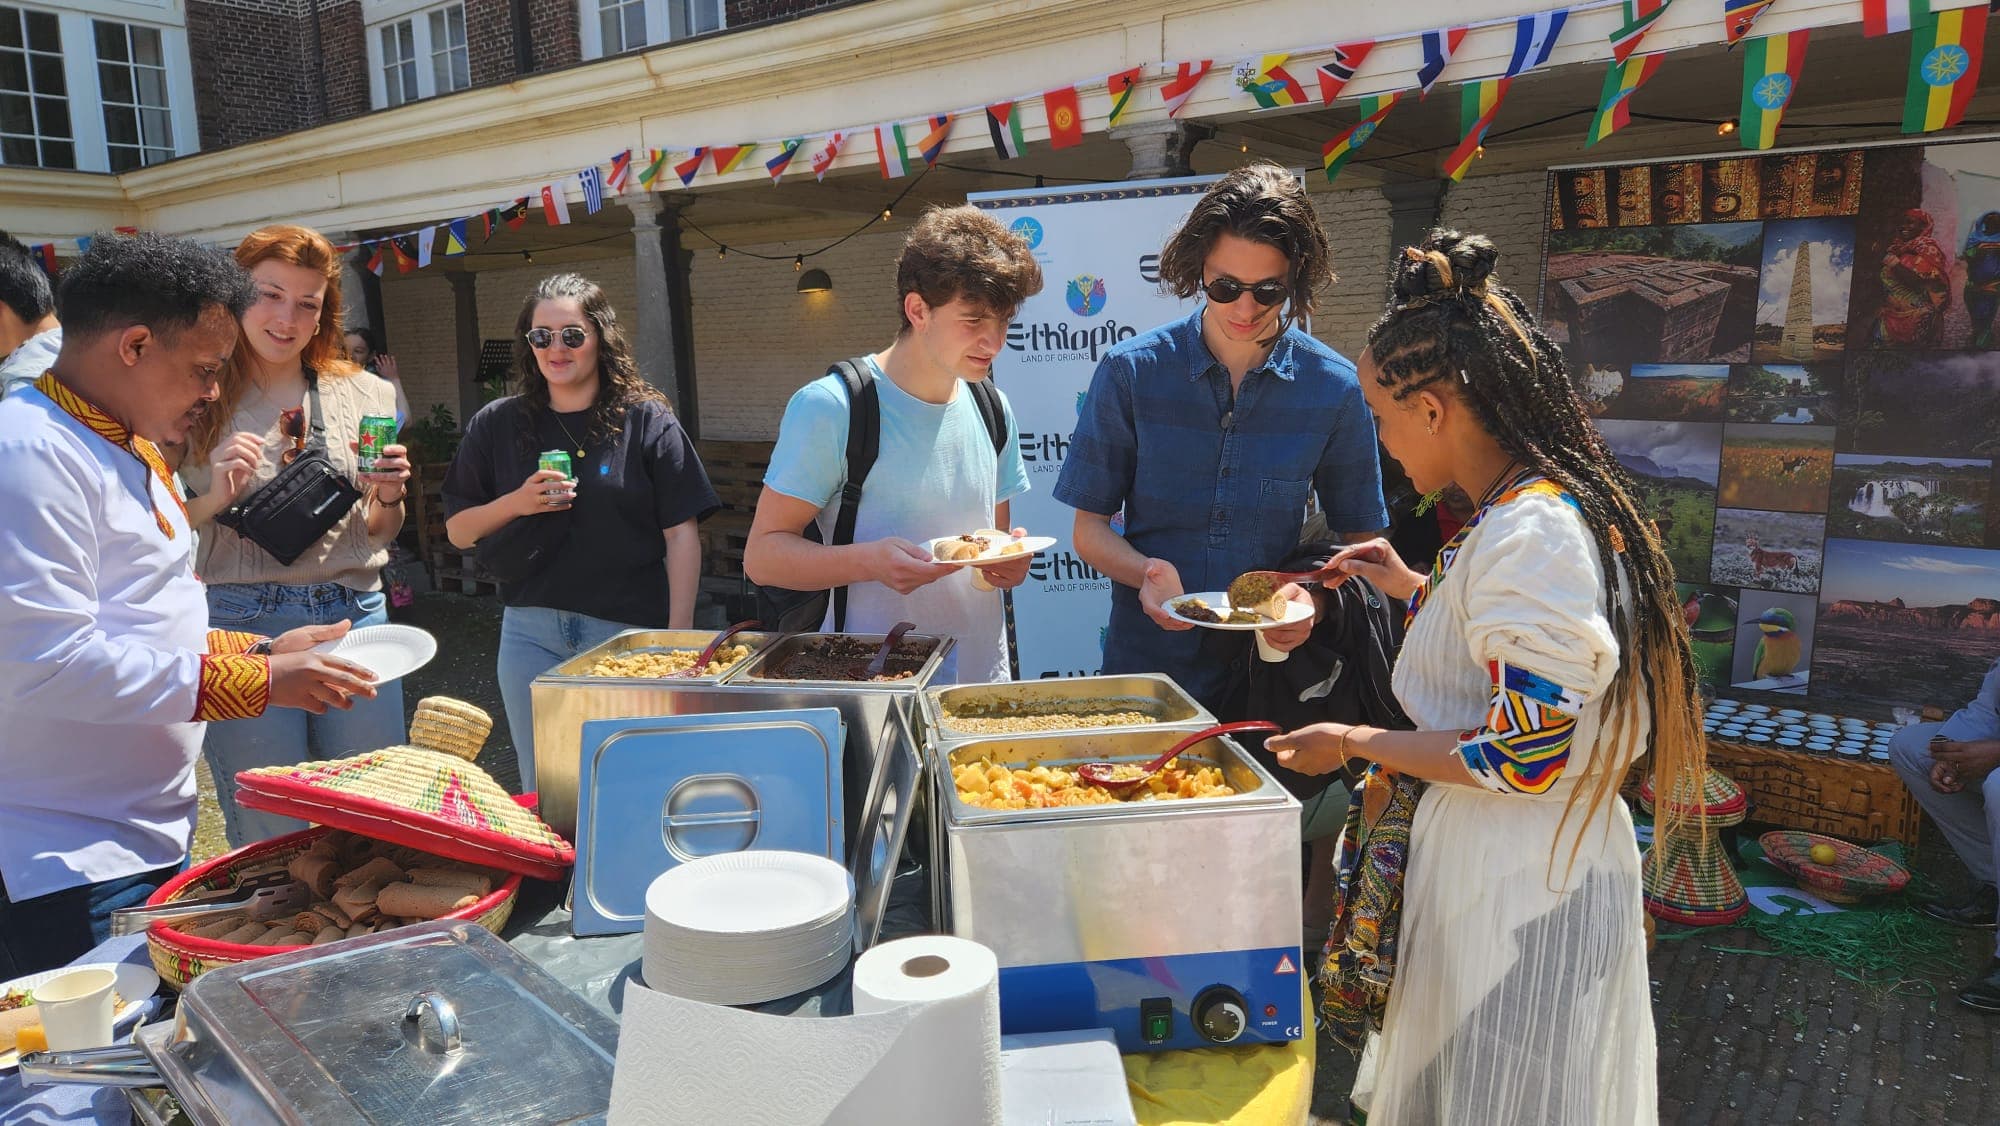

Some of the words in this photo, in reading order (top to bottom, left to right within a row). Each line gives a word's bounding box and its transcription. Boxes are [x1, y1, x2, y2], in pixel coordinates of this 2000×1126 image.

[1021, 354, 1042, 363] LAND
[1058, 353, 1089, 361] ORIGINS
[1043, 584, 1065, 592] LAND
[1067, 583, 1077, 591] OF
[1079, 582, 1110, 590] ORIGINS
